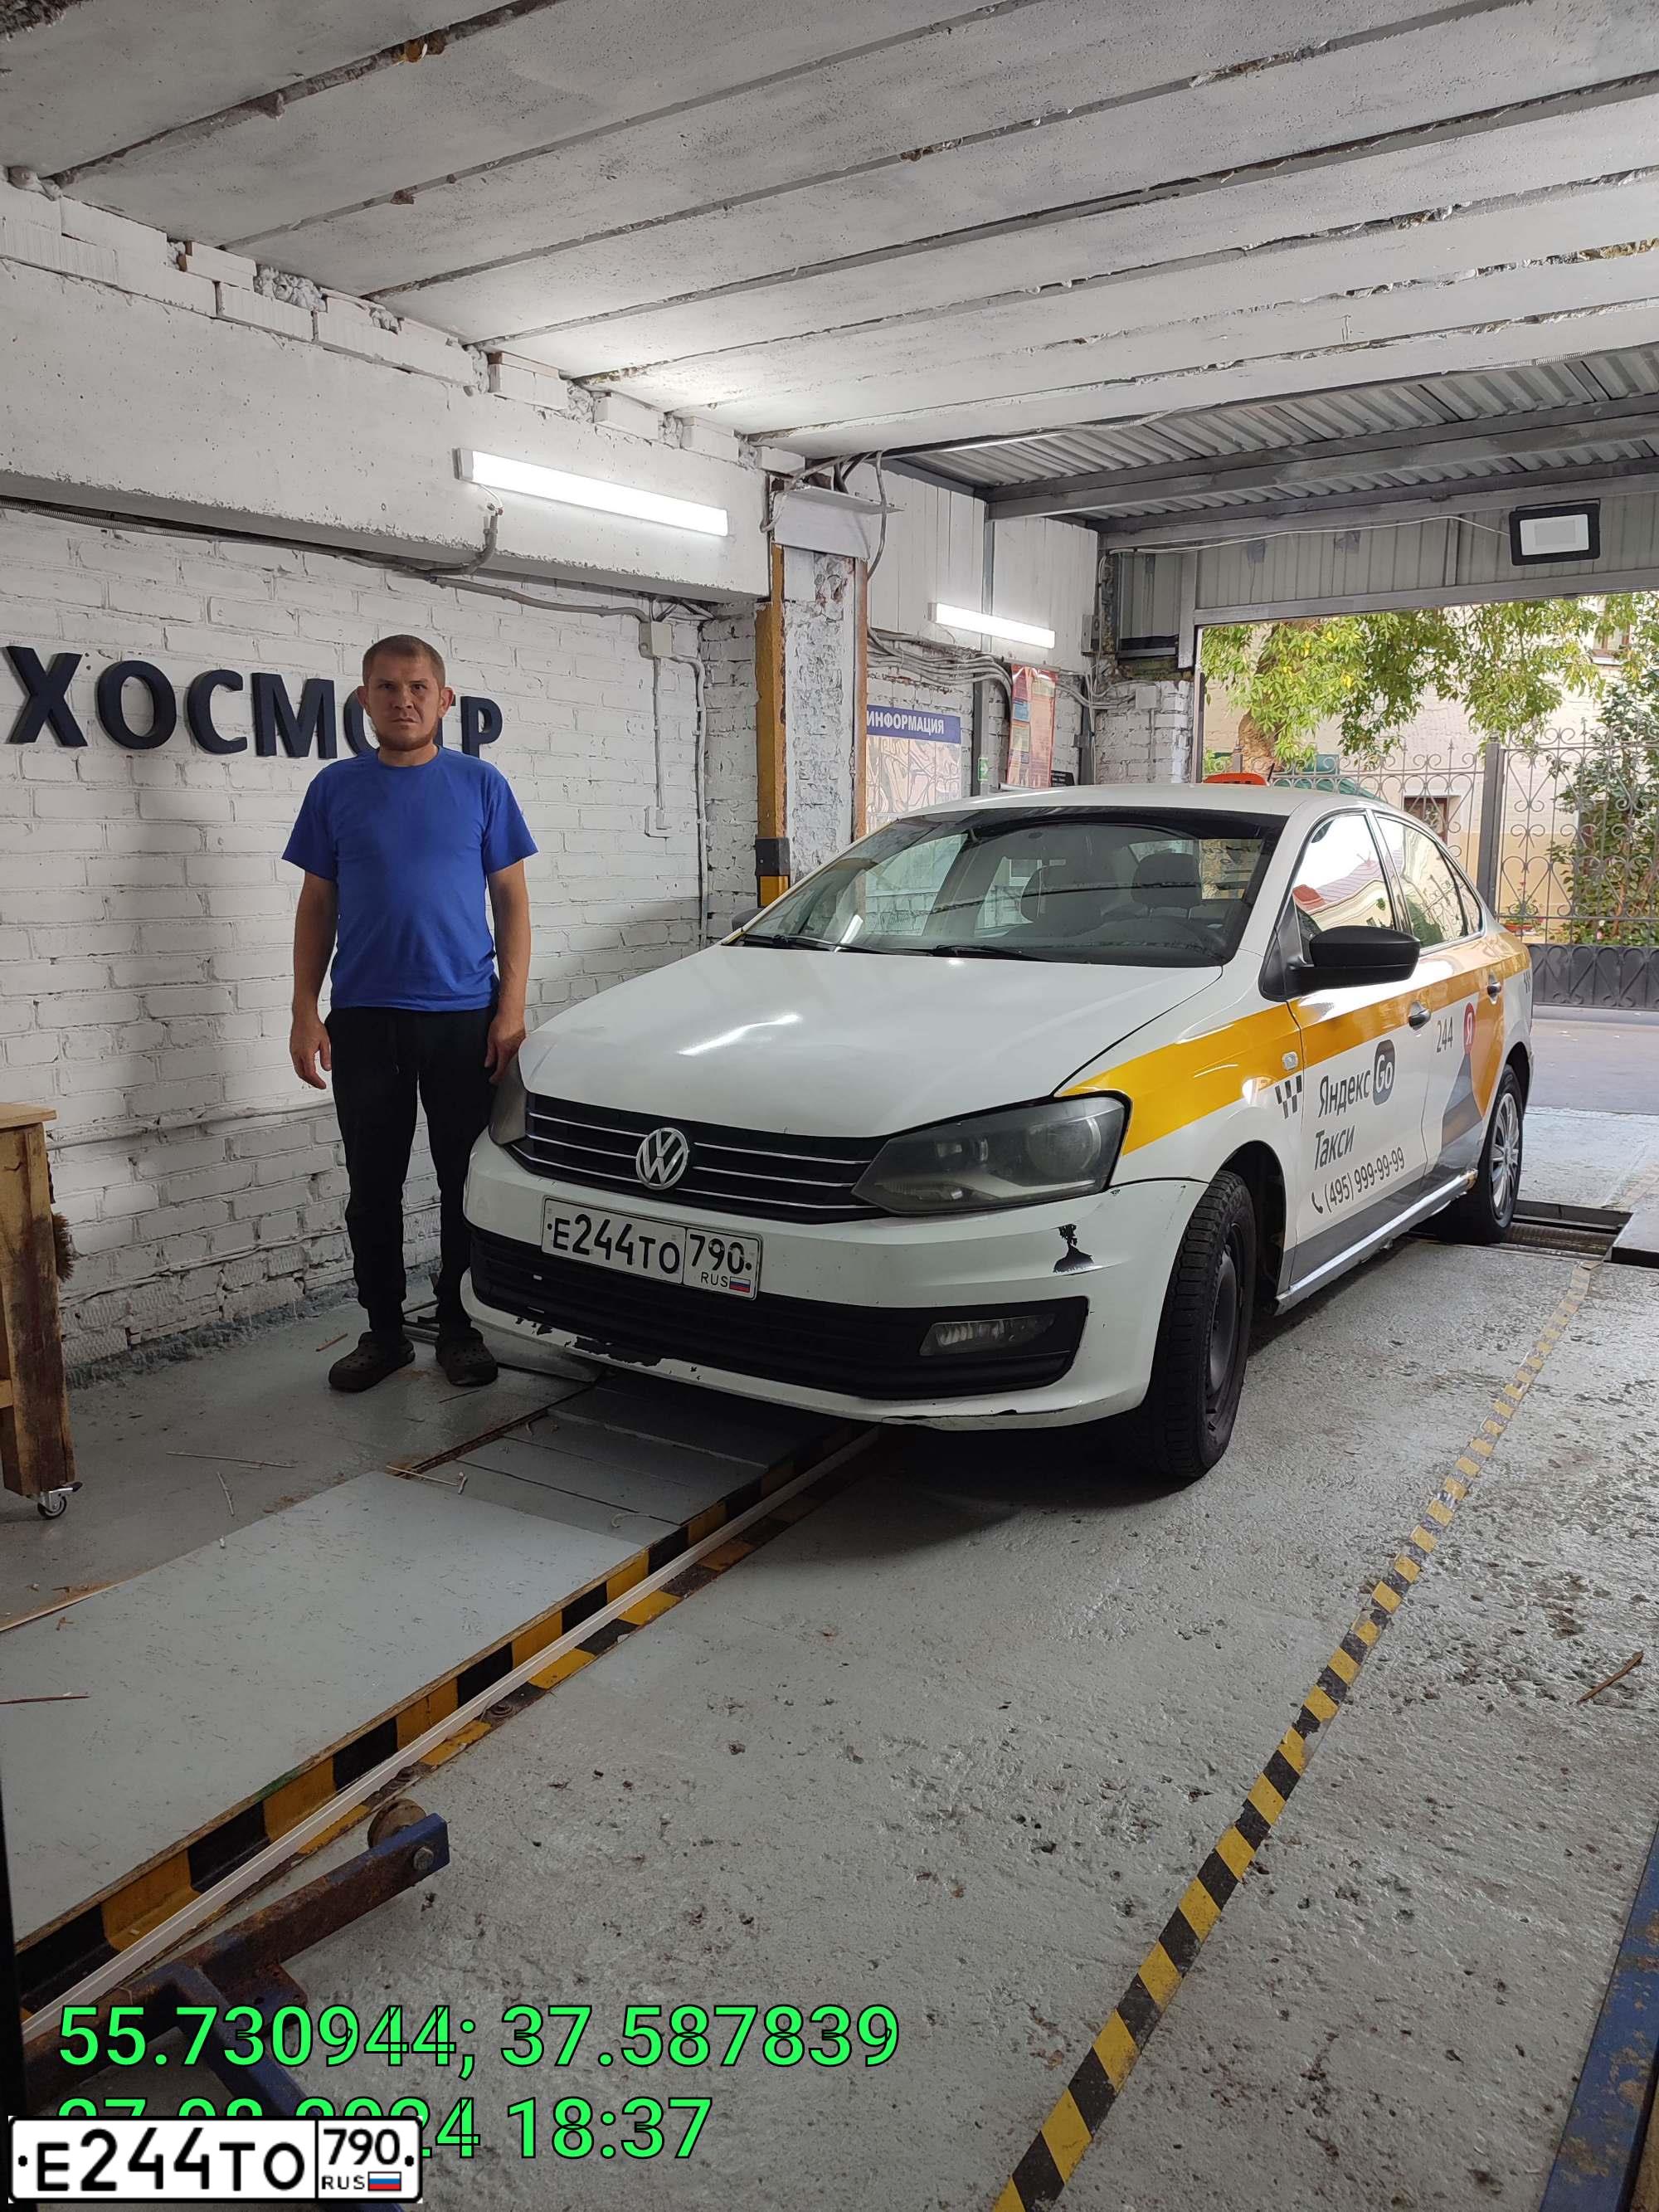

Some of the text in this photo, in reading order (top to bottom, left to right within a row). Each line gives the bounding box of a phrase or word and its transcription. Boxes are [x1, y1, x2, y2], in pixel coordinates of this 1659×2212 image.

[6, 646, 504, 759] ХОСМР
[867, 710, 945, 736] ИНФОРМАЦИЯ
[1436, 1016, 1453, 1053] 244
[1318, 1054, 1394, 1118] Яндекс Go
[1314, 1125, 1355, 1172] Такси
[1324, 1147, 1405, 1214] (495) 999-99-99
[552, 1213, 745, 1274] Е244ТО 790
[701, 1271, 728, 1288] RUS
